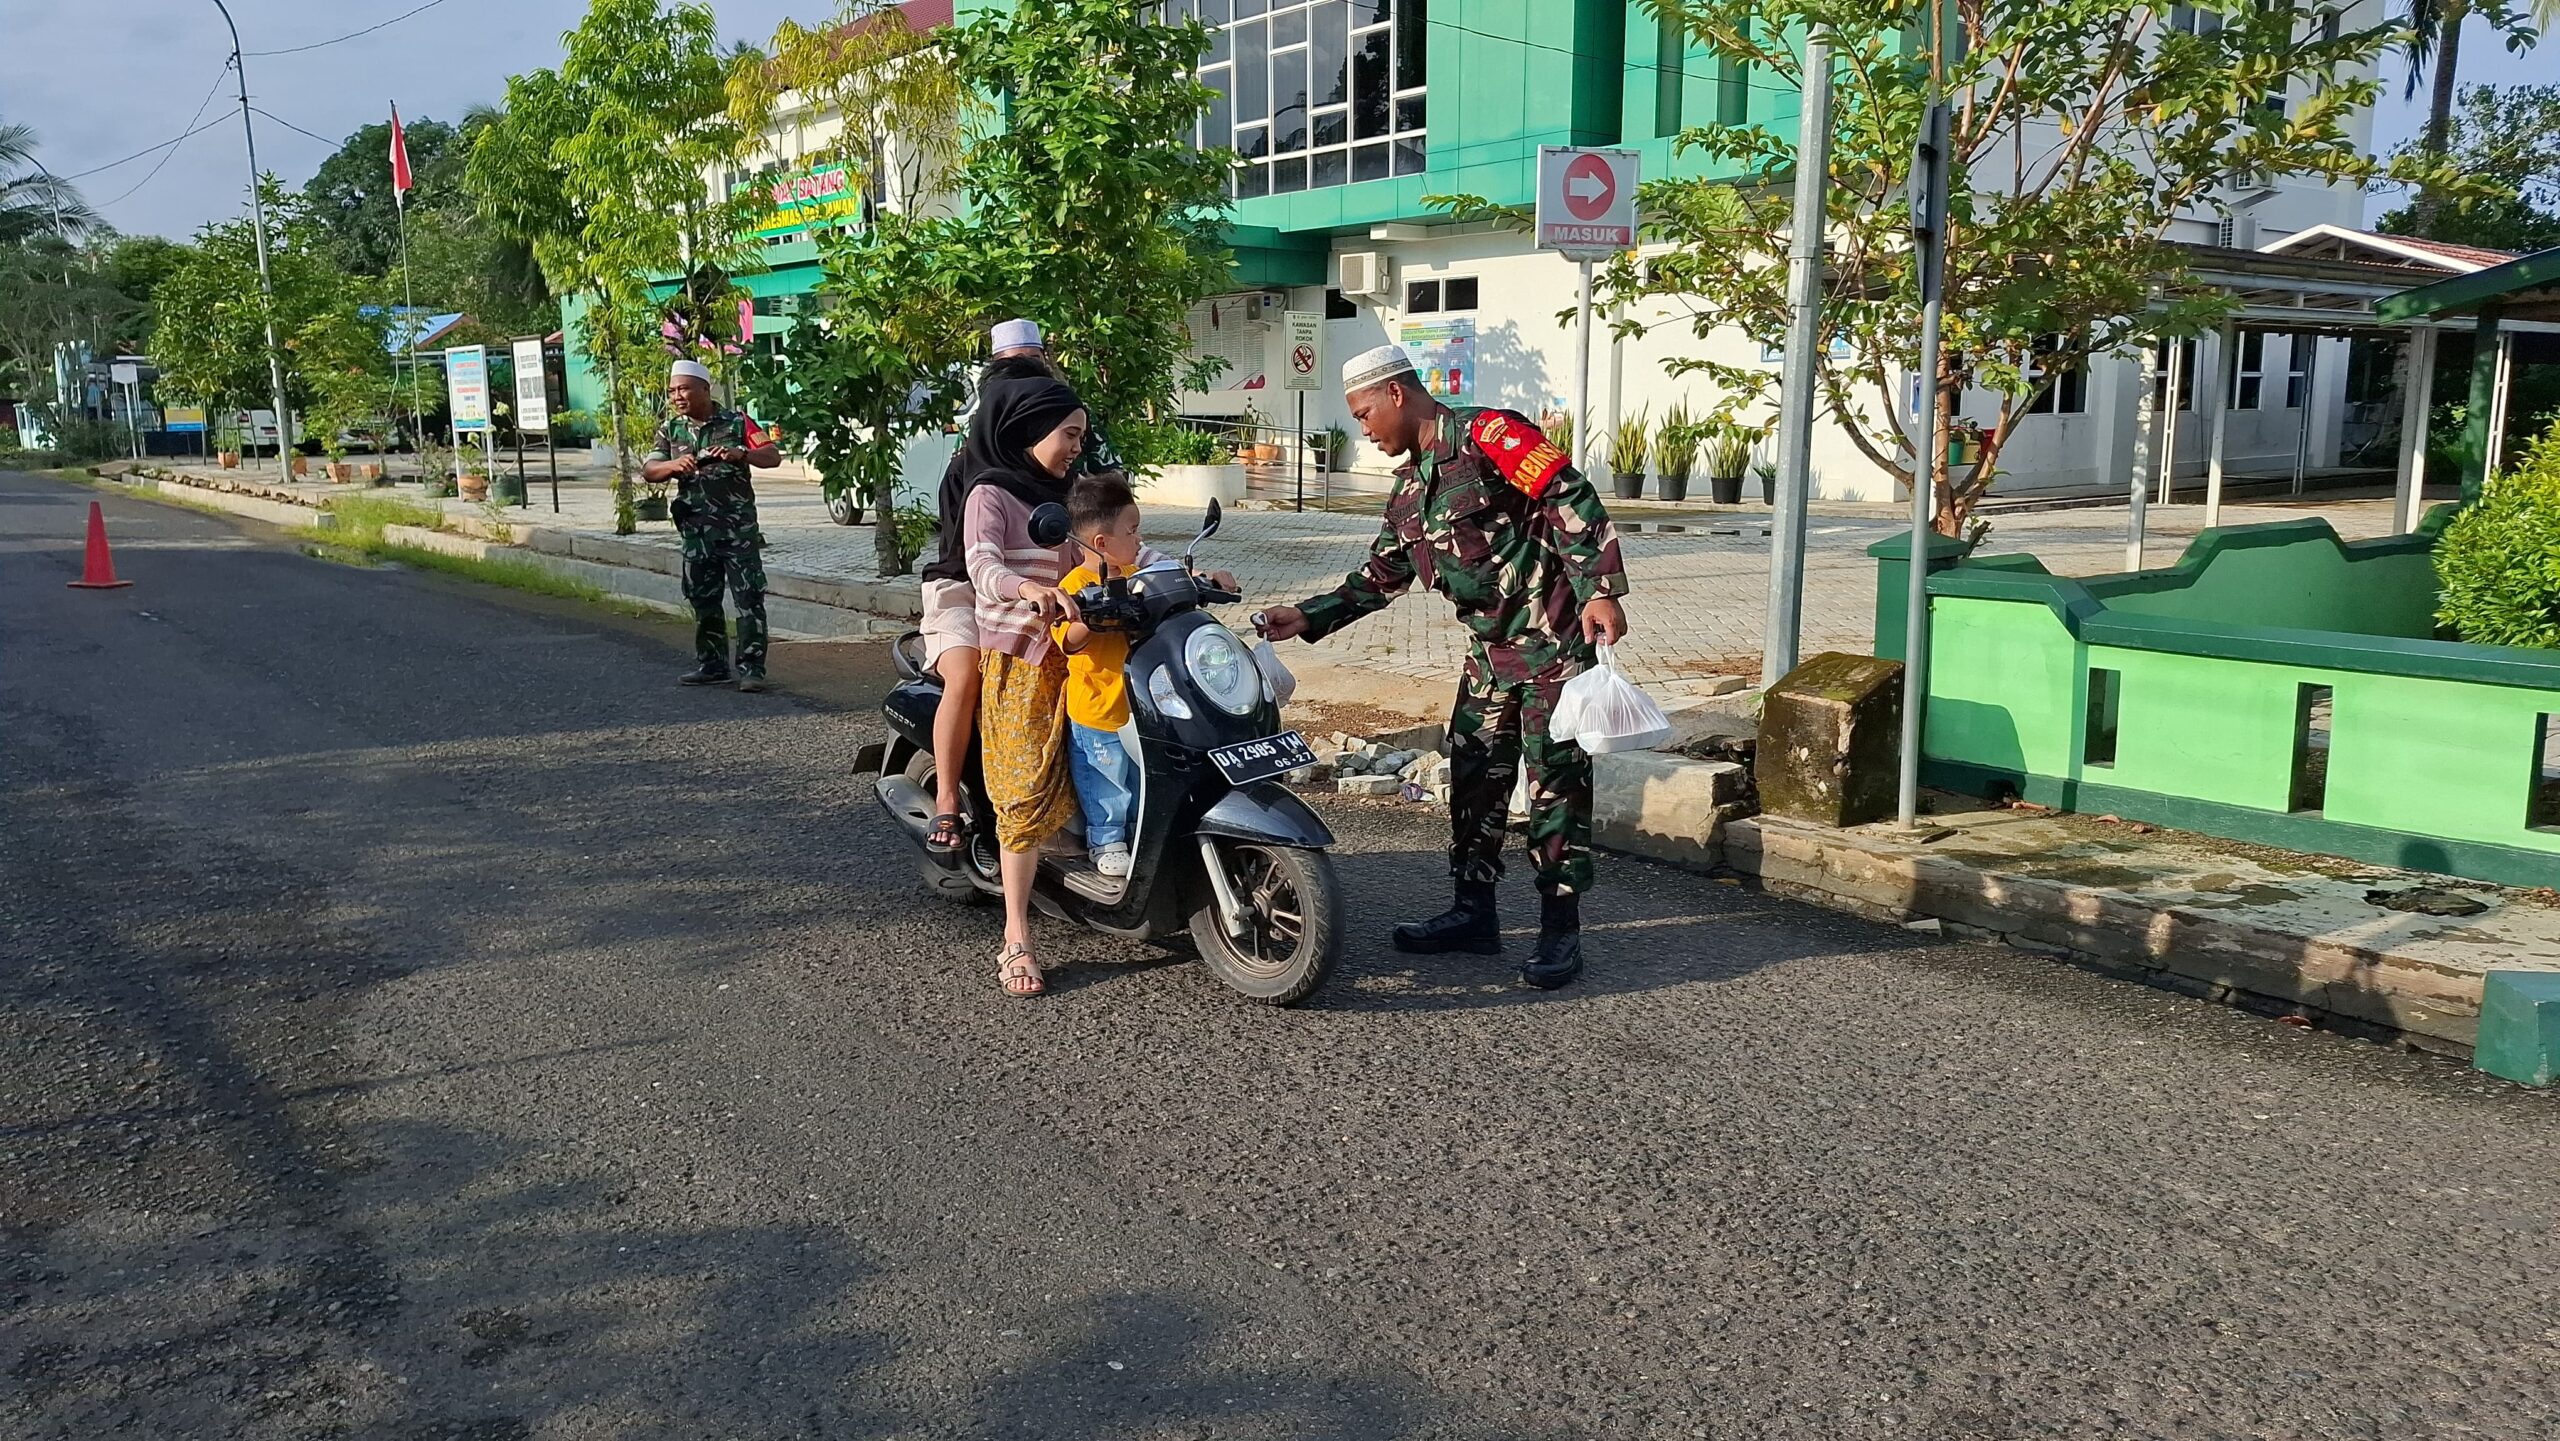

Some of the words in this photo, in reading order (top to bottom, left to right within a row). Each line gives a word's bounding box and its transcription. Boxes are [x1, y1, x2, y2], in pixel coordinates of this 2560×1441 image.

[753, 208, 801, 231] SKESMAS
[1554, 226, 1619, 242] MASUK
[1215, 750, 1241, 767] DA
[1238, 741, 1277, 761] 2985
[1276, 733, 1304, 751] YM
